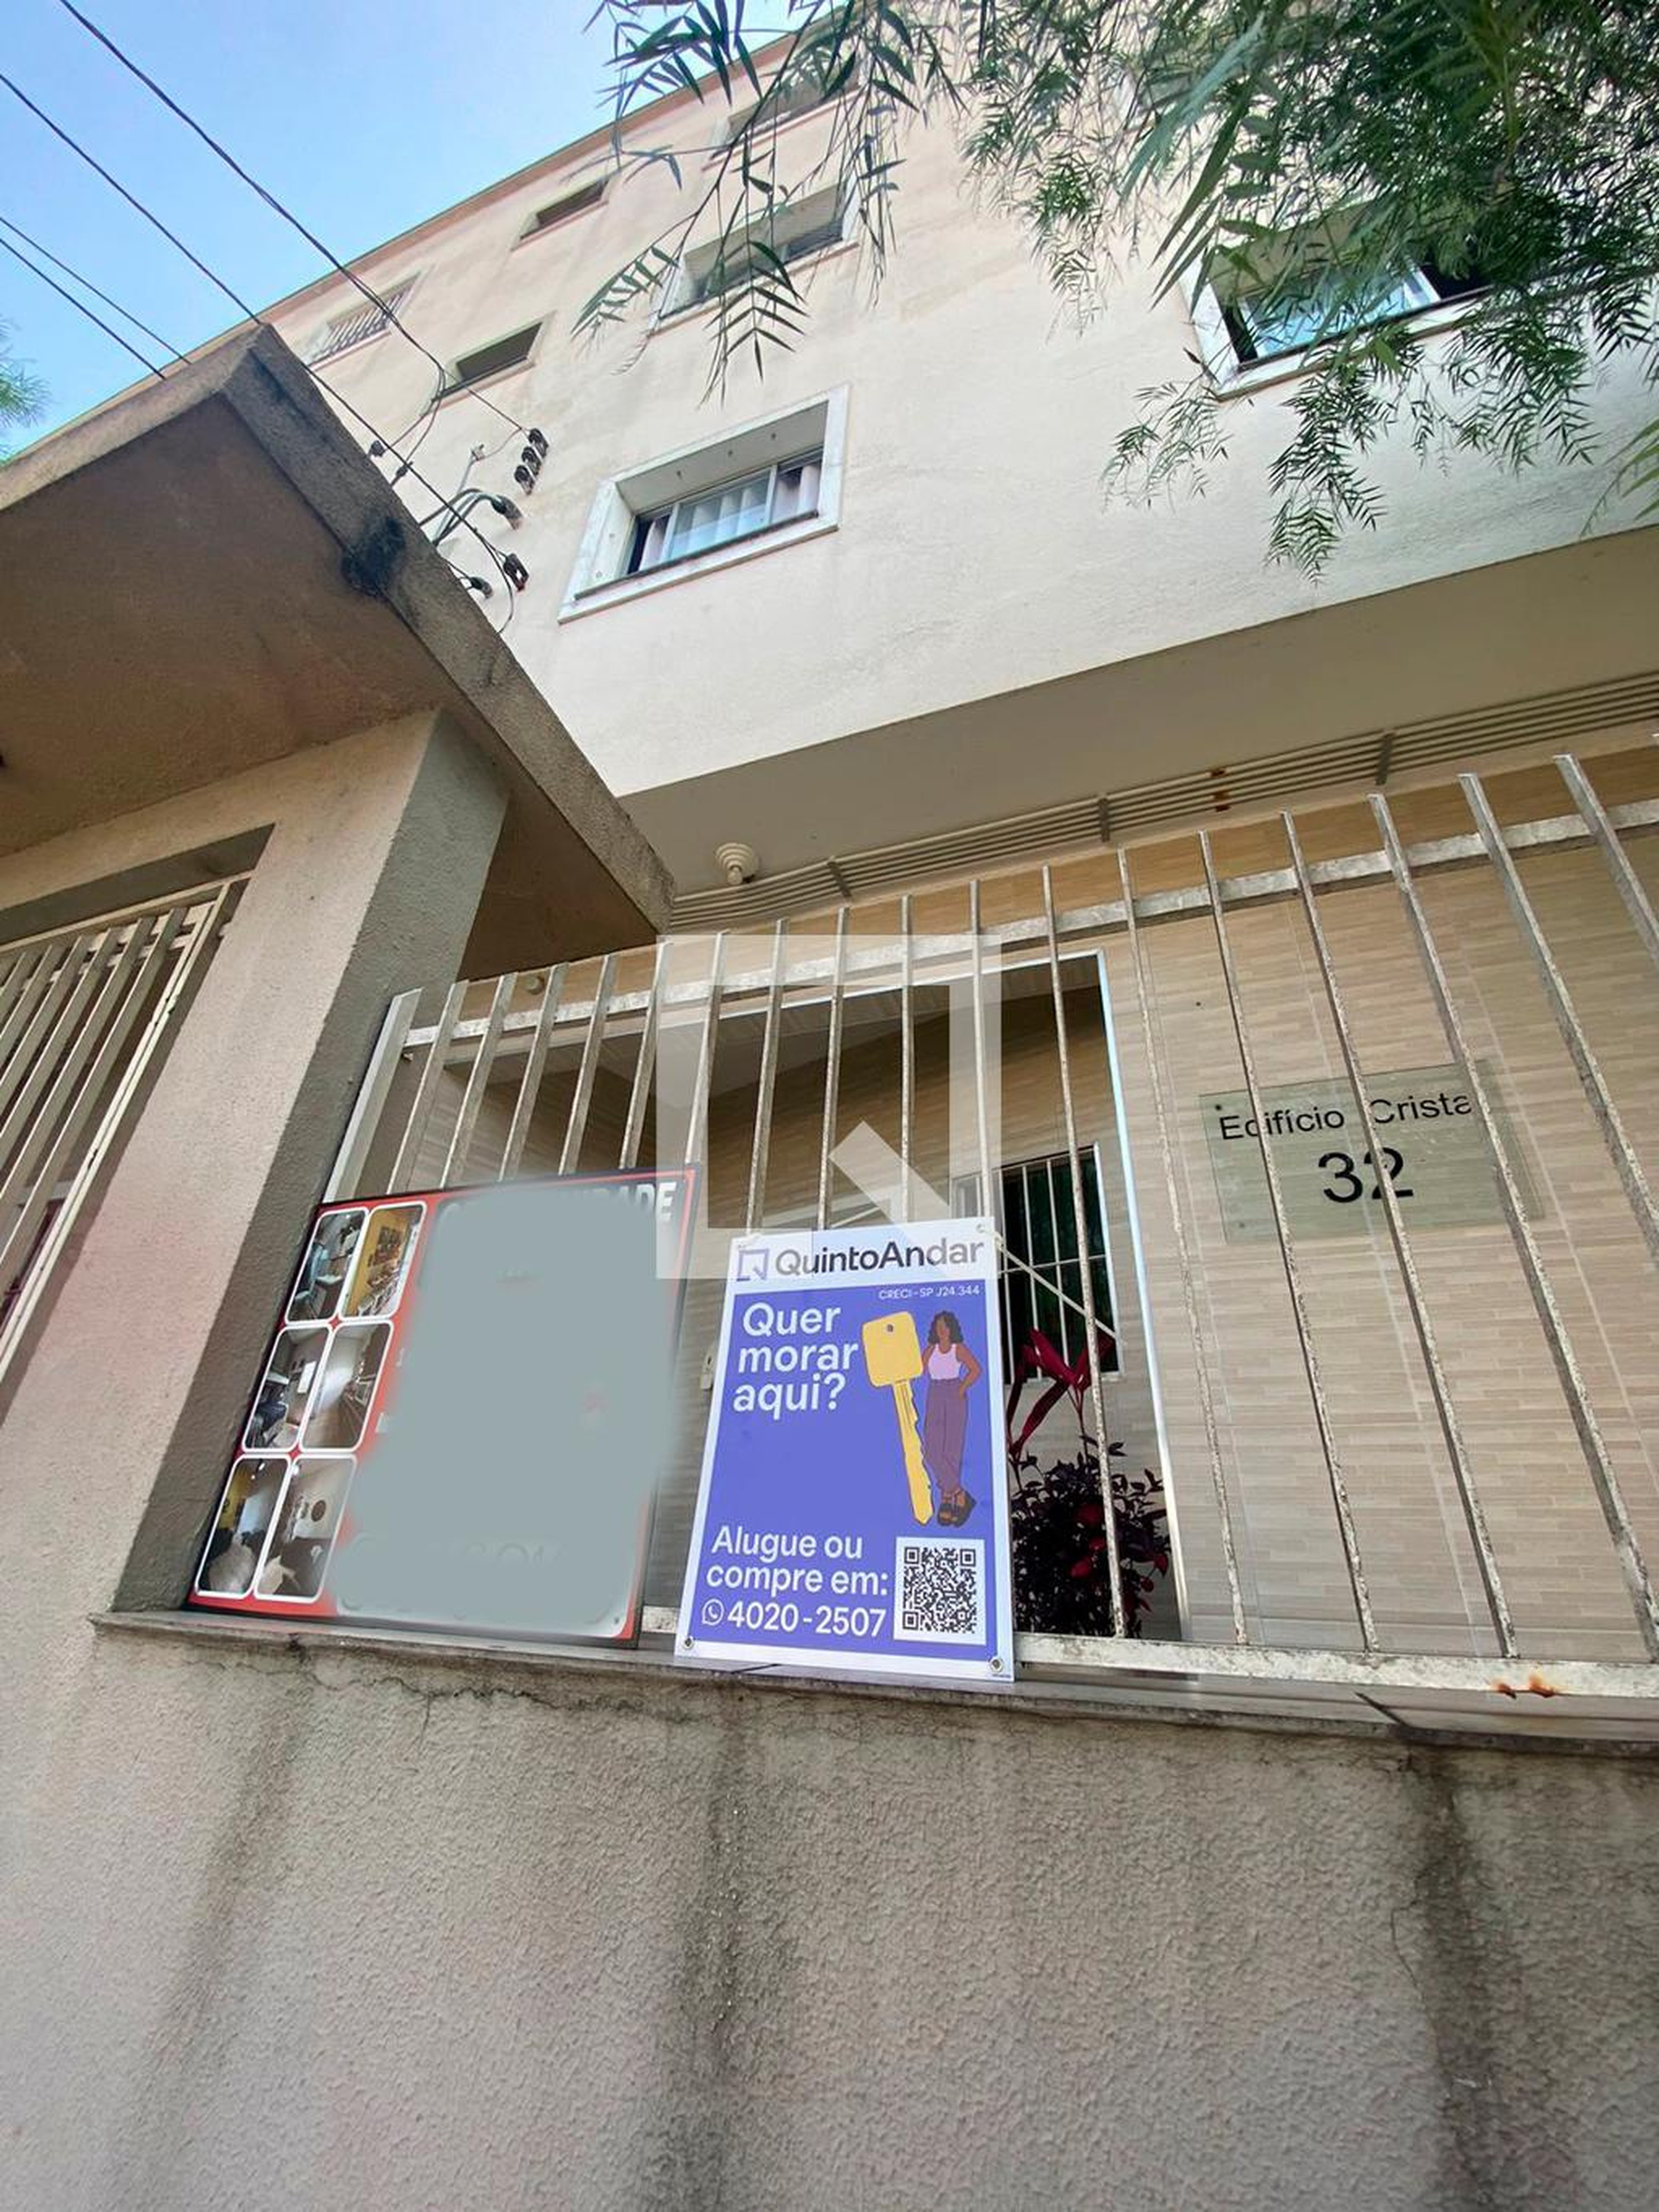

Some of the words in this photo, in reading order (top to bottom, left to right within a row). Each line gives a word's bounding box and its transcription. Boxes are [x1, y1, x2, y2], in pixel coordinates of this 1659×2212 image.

[1370, 1093, 1472, 1124] Crista
[1318, 1148, 1414, 1203] 32
[777, 1238, 985, 1276] QuintoAndar
[743, 1303, 841, 1337] Quer
[738, 1343, 858, 1373] morar
[733, 1373, 846, 1420] aqui?
[712, 1526, 817, 1563] Alugue
[824, 1536, 863, 1559] ou
[706, 1565, 823, 1597] compre
[830, 1570, 889, 1595] em:
